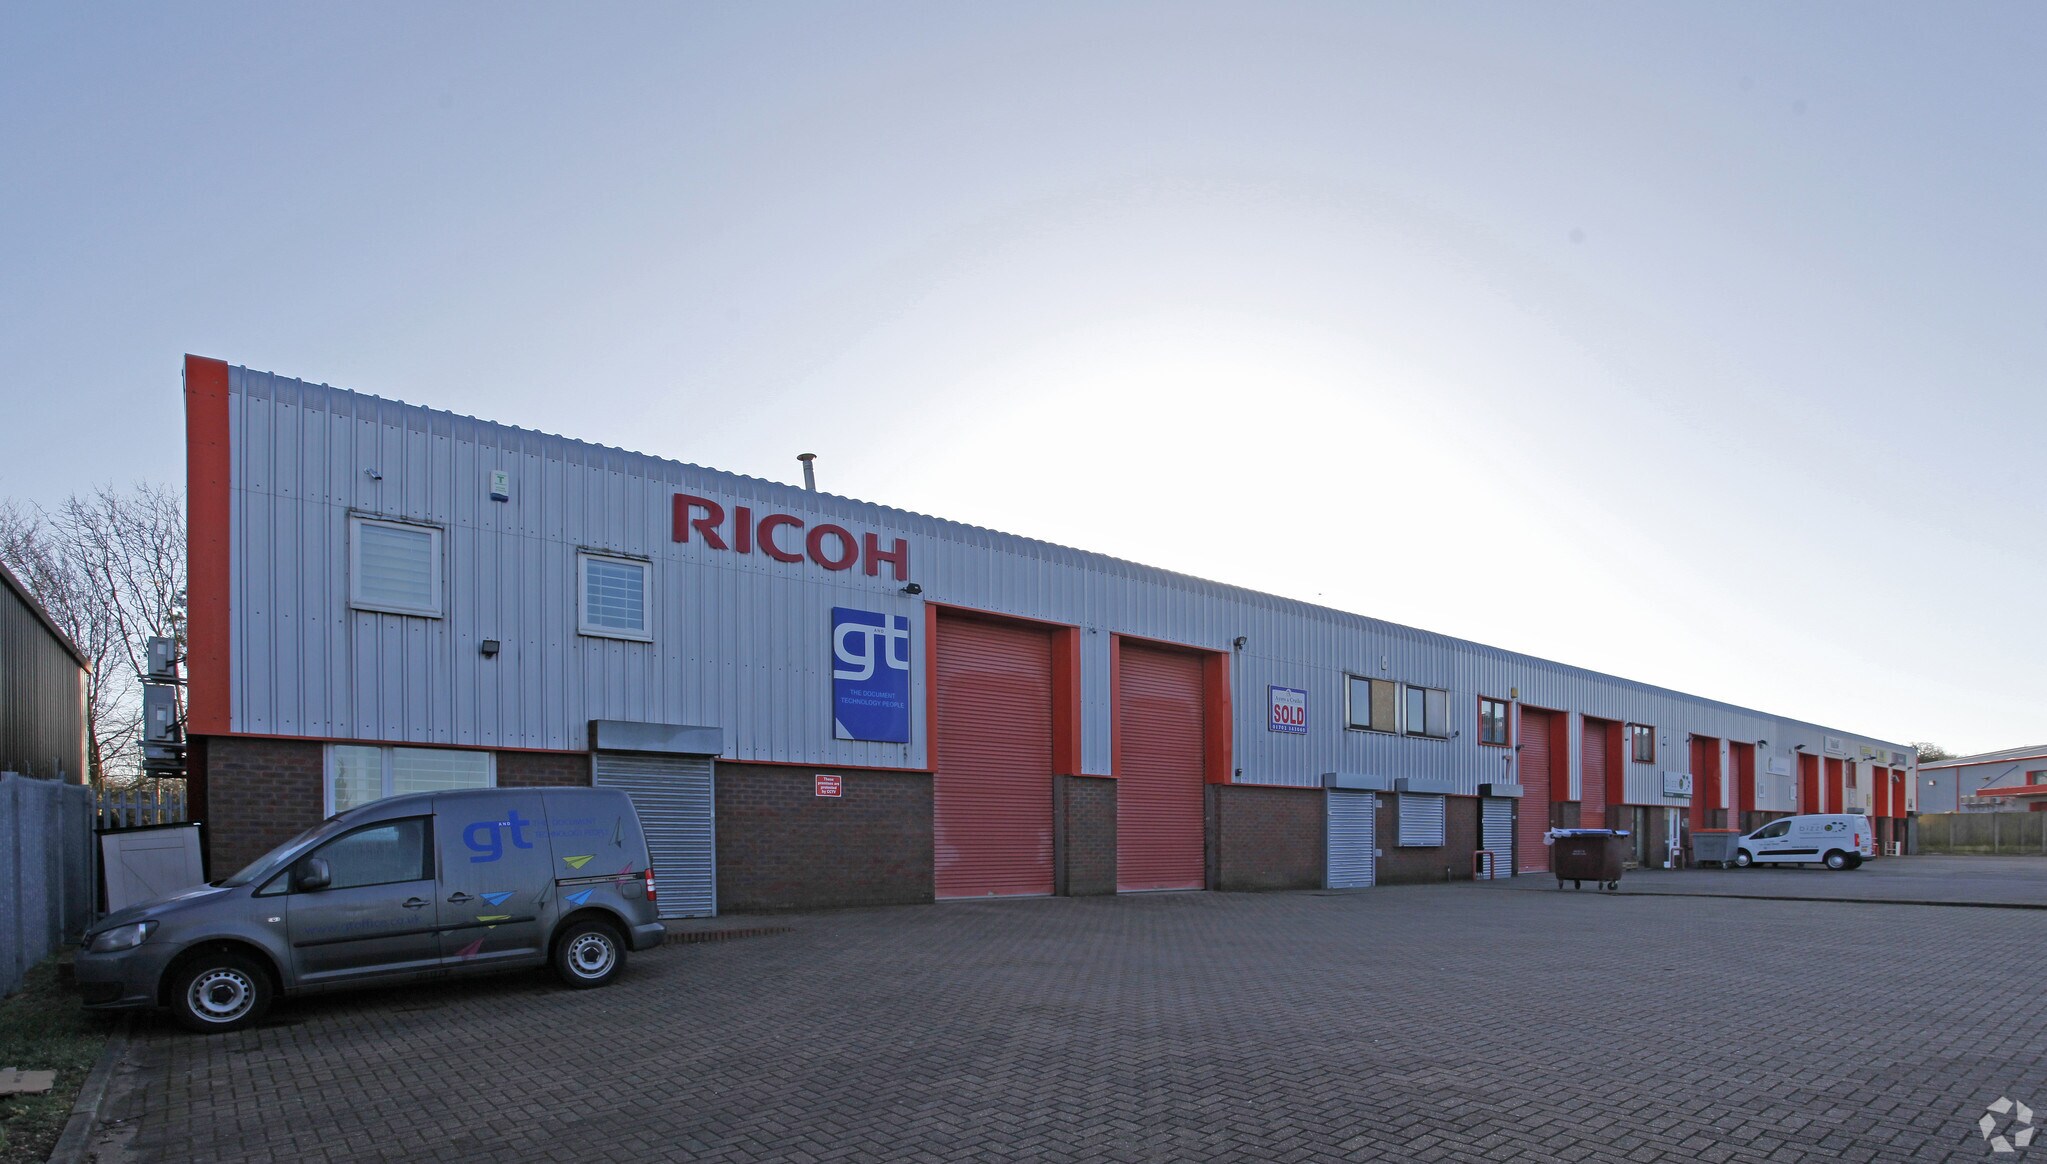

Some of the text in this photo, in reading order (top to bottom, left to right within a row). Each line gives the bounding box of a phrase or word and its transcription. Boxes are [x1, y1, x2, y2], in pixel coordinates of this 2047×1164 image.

[673, 493, 908, 582] RICOH
[834, 614, 908, 681] gt
[841, 697, 905, 709] TECHNOLOGY PEOPLE
[863, 690, 896, 699] DOCUMENT
[1274, 704, 1304, 725] SOLD
[462, 810, 533, 863] gt
